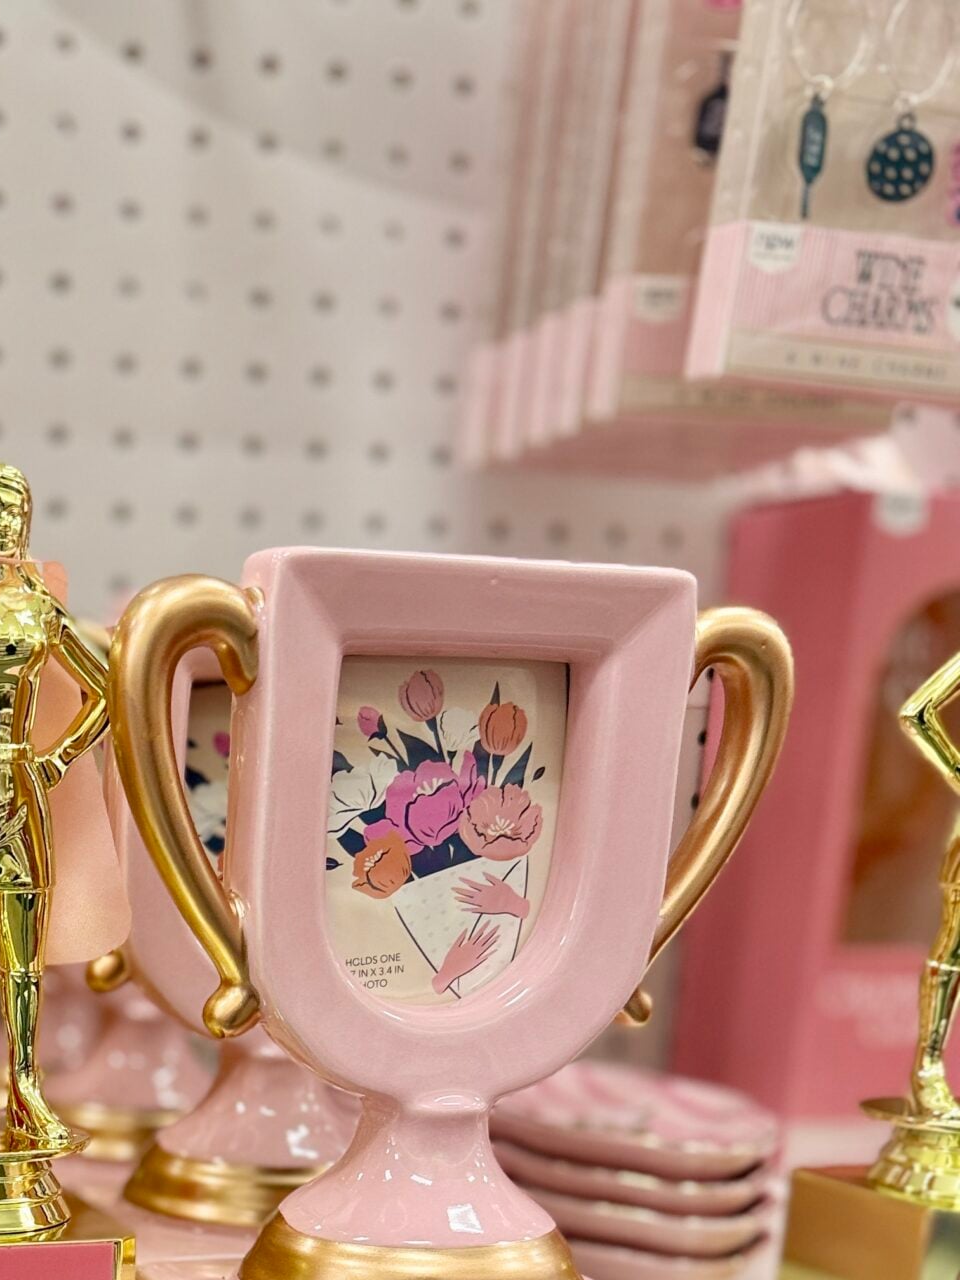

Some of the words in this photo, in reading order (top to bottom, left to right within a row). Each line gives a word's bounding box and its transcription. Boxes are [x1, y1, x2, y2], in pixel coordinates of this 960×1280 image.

[345, 955, 378, 967] HOLDS
[380, 953, 401, 963] ONE
[359, 969, 368, 978] IN
[370, 968, 376, 976] X
[394, 965, 404, 975] IN
